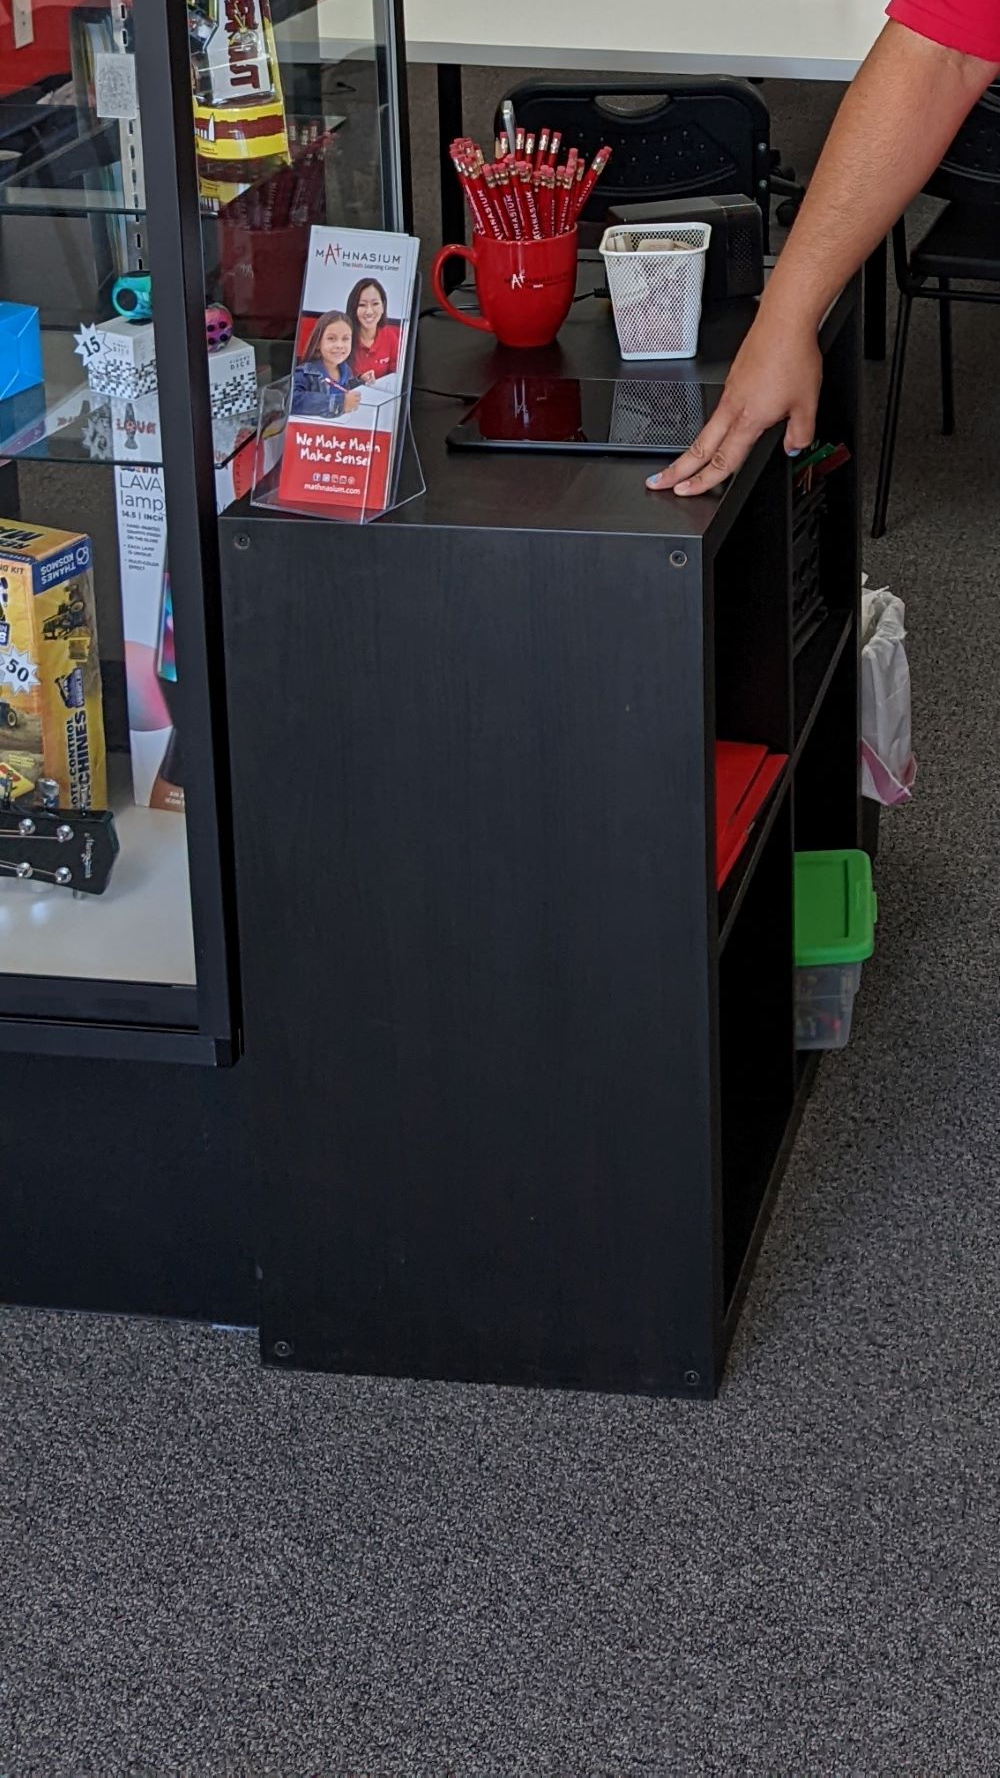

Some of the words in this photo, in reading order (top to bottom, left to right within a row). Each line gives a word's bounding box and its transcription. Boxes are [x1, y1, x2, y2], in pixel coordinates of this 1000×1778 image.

[82, 335, 101, 358] 15
[296, 431, 313, 447] We
[315, 434, 346, 450] Make
[349, 437, 381, 453] Math
[300, 447, 332, 462] Make
[119, 473, 163, 493] LAVA
[304, 482, 361, 495] mathnasium.com
[120, 490, 164, 513] lamp
[143, 512, 164, 523] INCH
[11, 566, 24, 575] KIT
[6, 658, 30, 683] 50
[75, 709, 92, 808] CHINES
